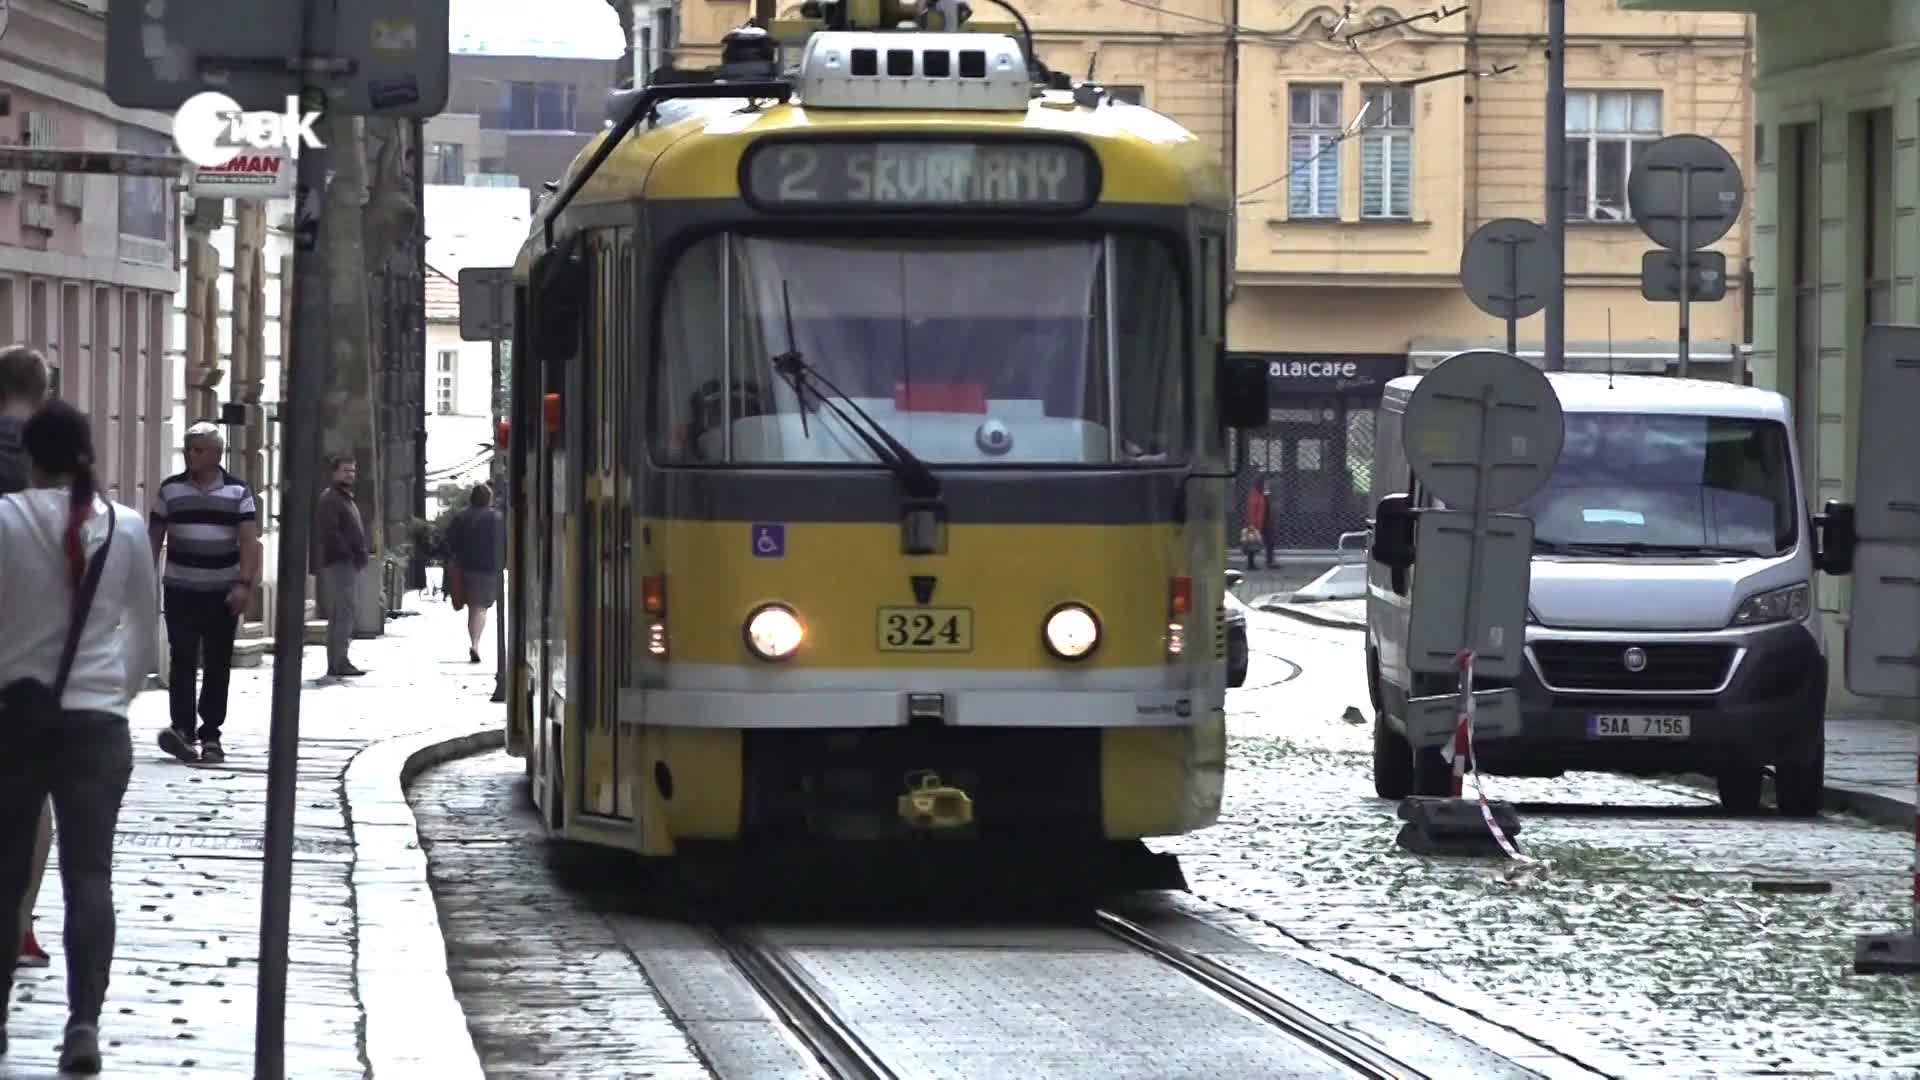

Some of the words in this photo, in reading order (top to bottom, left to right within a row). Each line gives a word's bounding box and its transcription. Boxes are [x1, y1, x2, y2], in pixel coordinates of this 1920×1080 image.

[199, 155, 281, 172] MAN
[779, 150, 817, 199] 2
[887, 614, 961, 646] 324
[1600, 717, 1630, 734] 5AA
[1643, 717, 1682, 734] 7156
